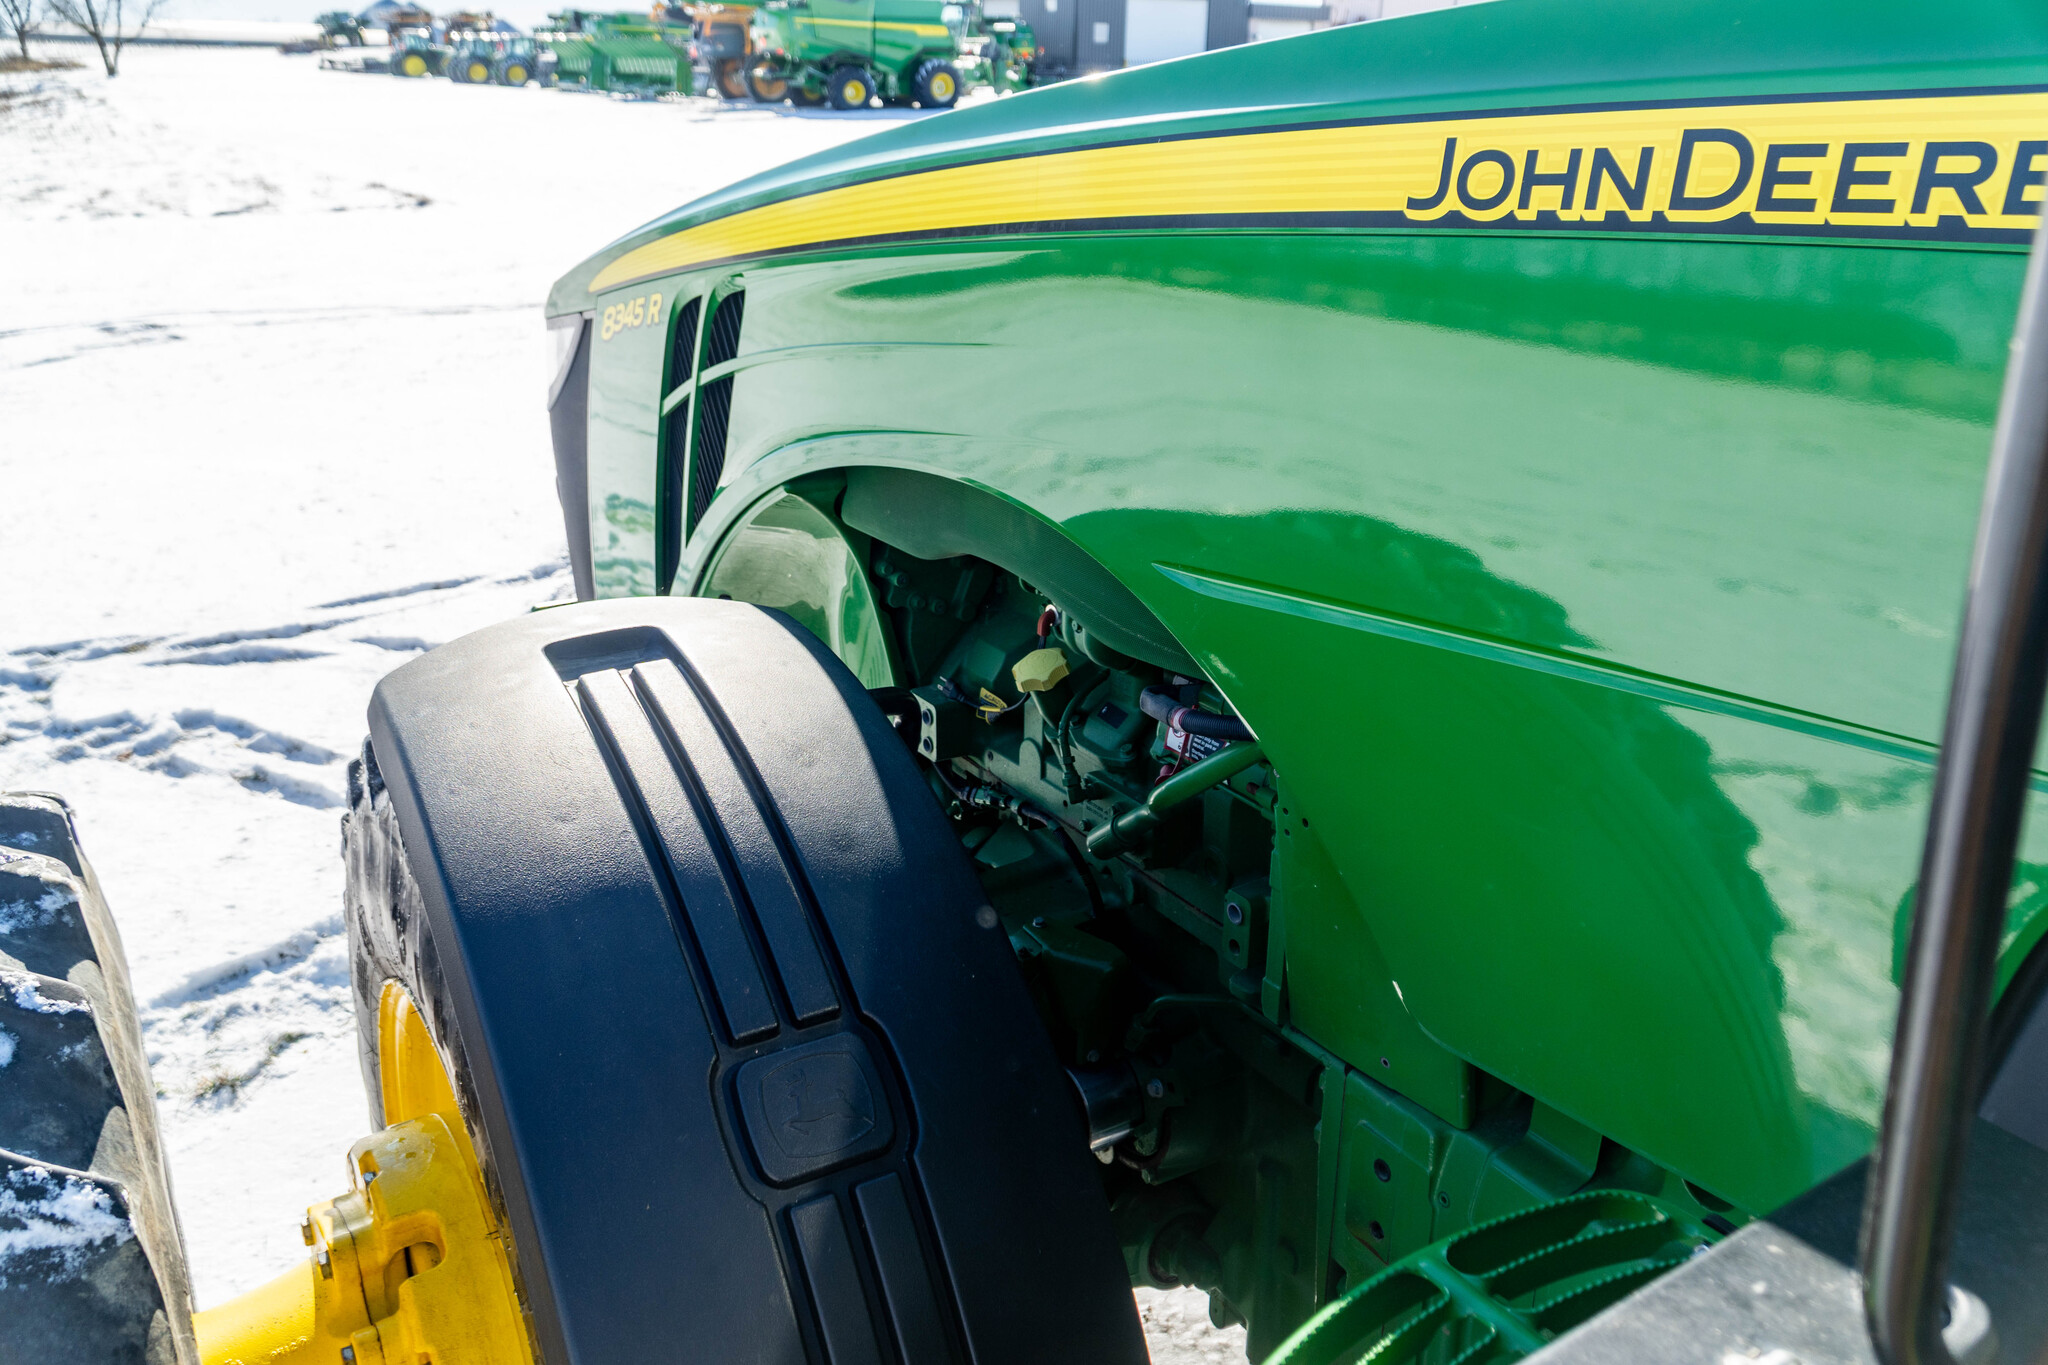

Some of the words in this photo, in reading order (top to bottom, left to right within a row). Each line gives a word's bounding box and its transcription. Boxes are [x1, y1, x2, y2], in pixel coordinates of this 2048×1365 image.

[1405, 136, 1656, 212] JOHN
[1668, 128, 2048, 217] DEERE
[601, 296, 646, 341] 8345
[647, 292, 663, 326] R
